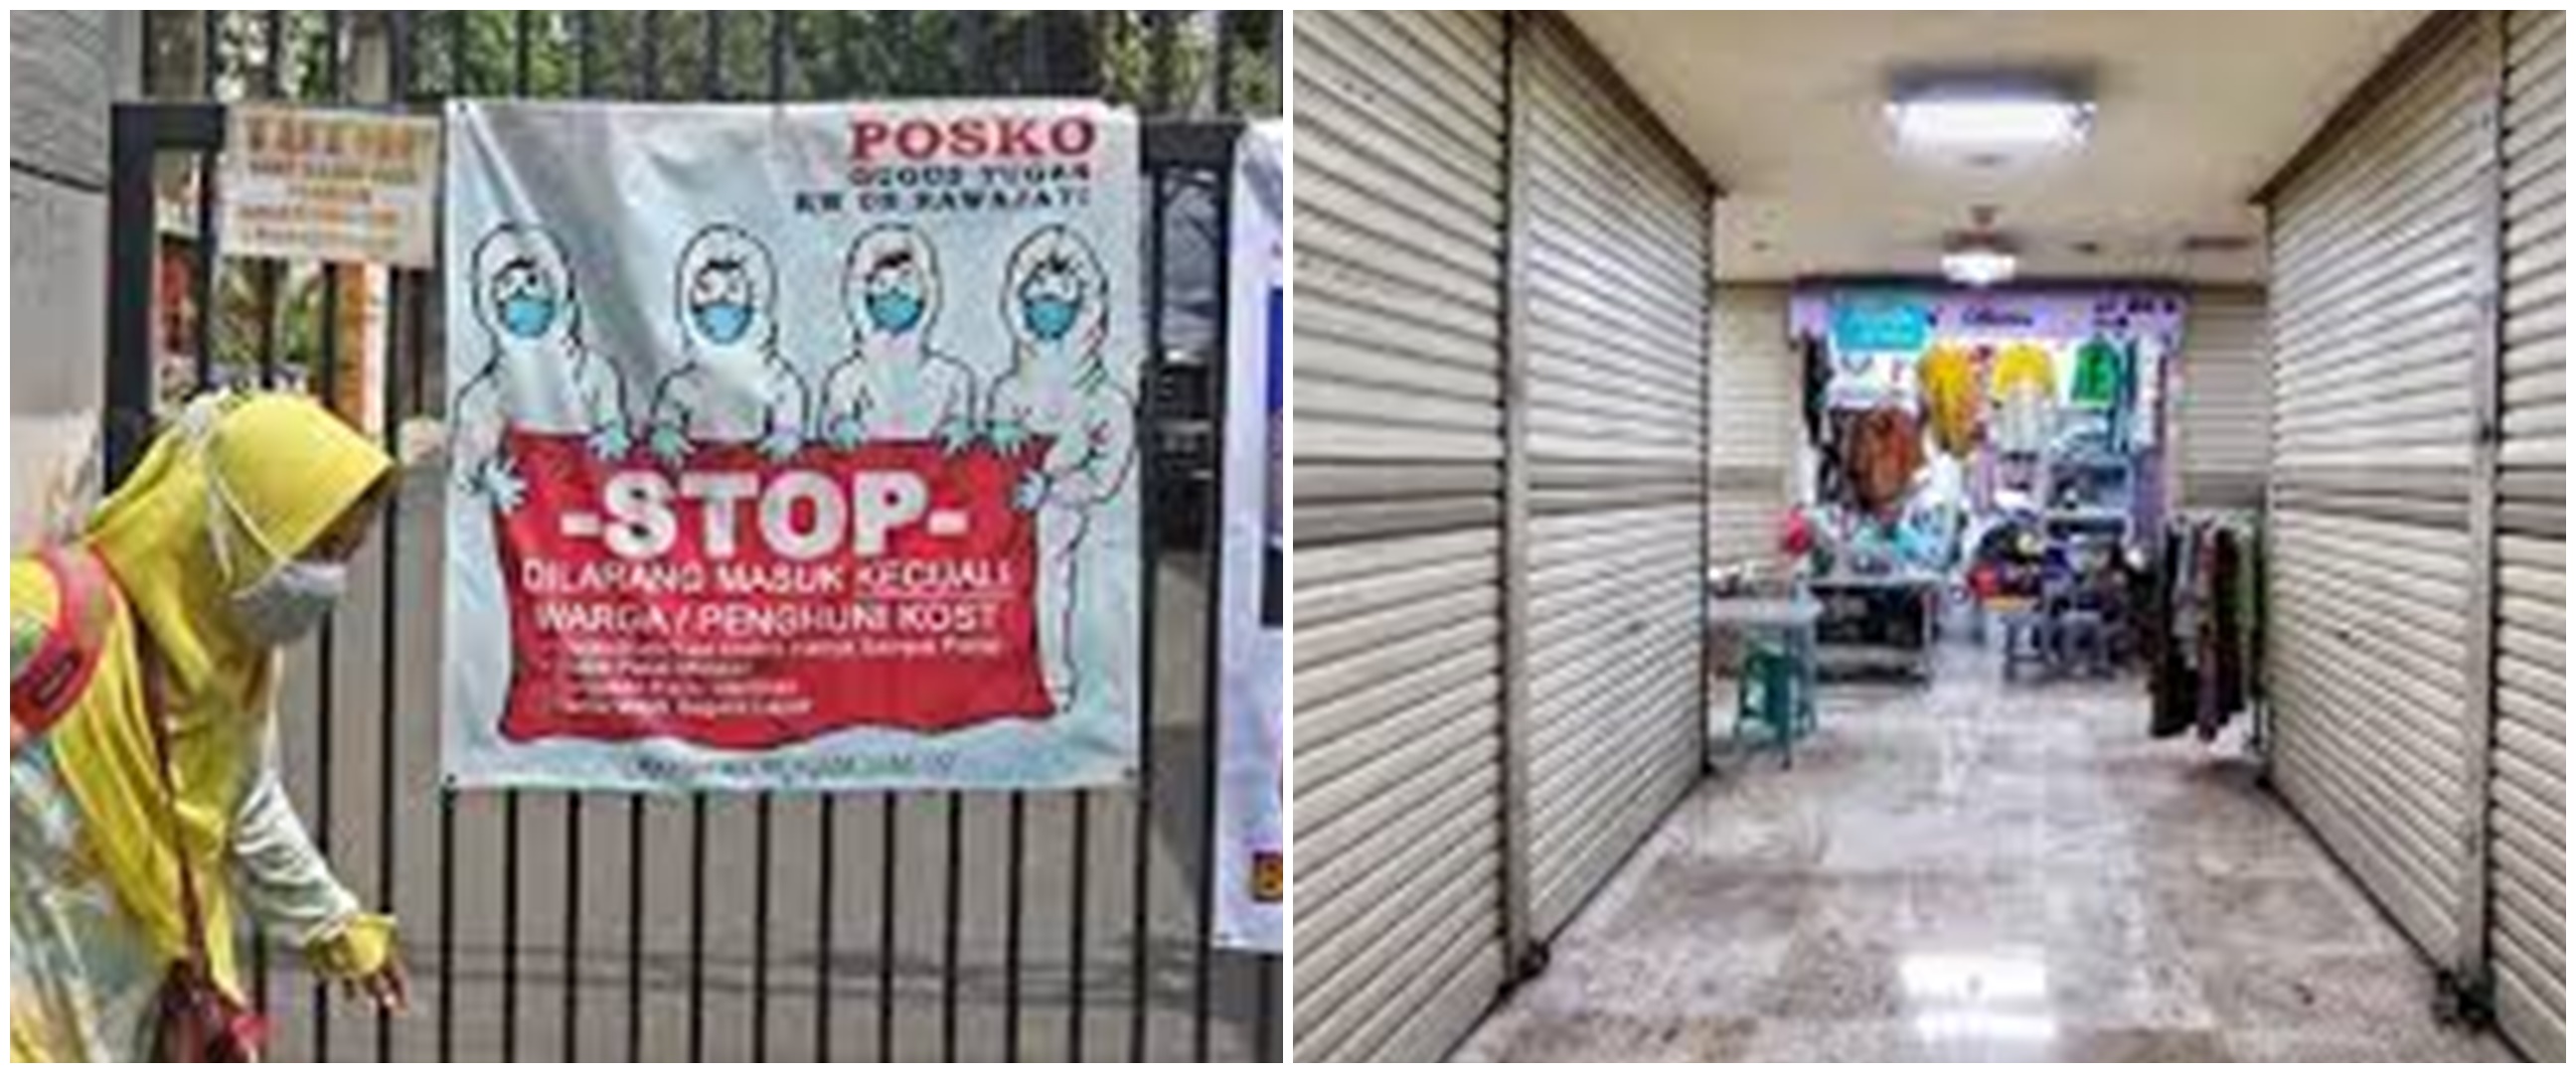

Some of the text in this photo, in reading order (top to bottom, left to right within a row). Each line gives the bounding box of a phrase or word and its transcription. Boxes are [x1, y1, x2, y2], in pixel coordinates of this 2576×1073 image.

[851, 116, 1097, 160] POSKO
[521, 558, 1012, 594] DILARANG MASUK KECUALI
[535, 602, 672, 635] WARGA
[697, 604, 890, 636] PENGHUNI
[896, 601, 998, 633] KOST
